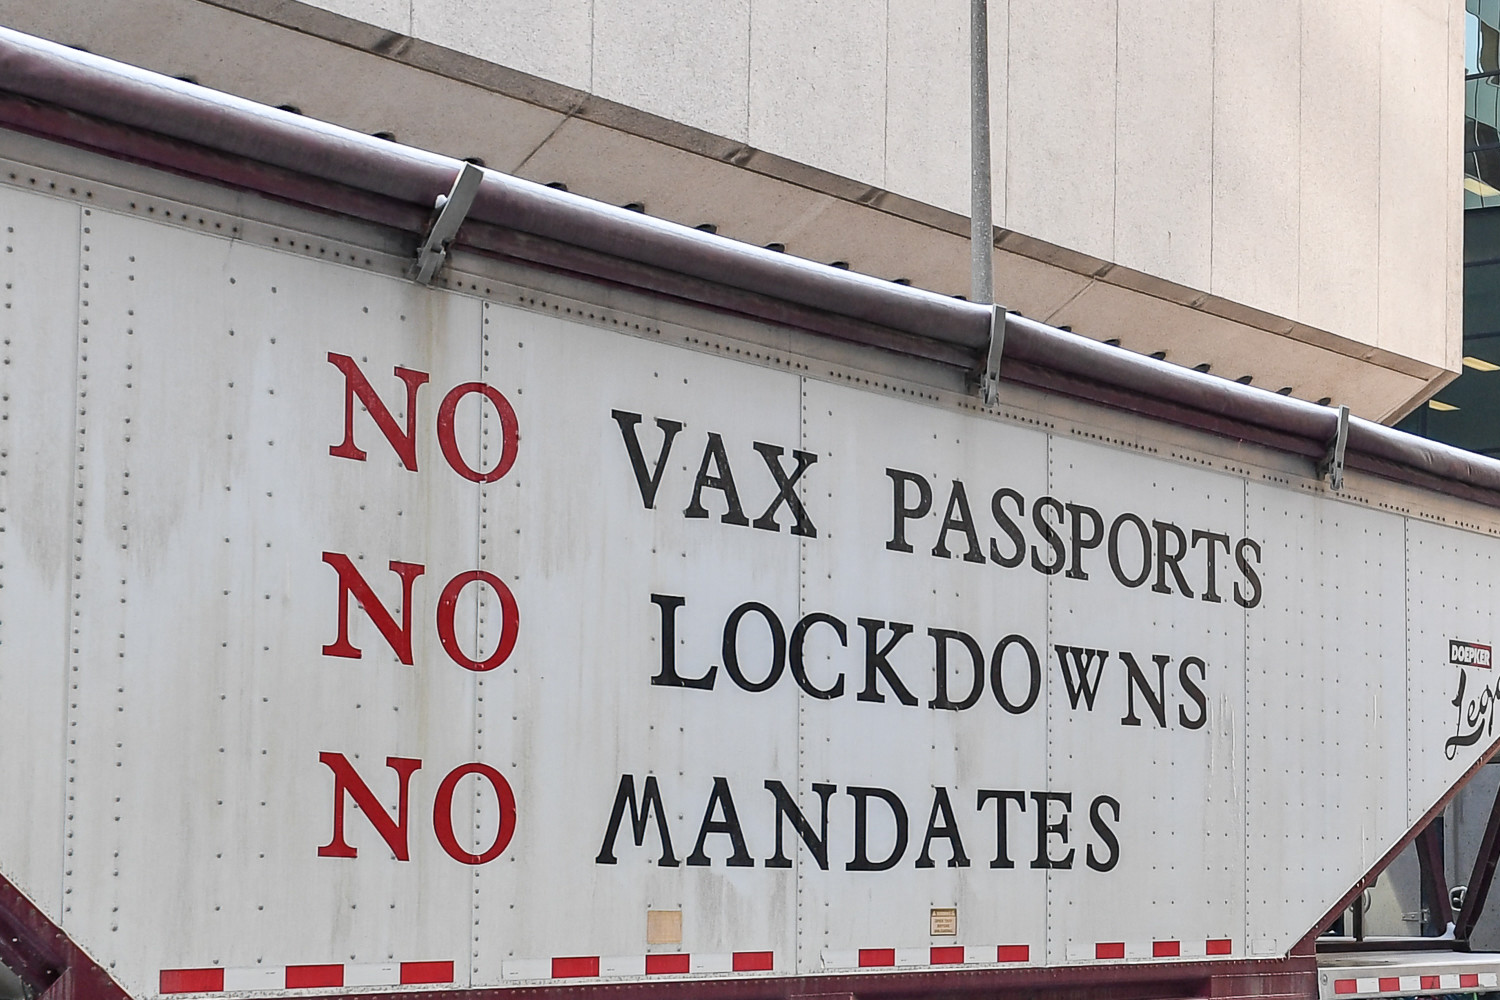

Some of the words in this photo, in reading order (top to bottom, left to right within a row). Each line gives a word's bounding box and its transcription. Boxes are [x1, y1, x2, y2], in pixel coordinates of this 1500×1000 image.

[327, 352, 519, 483] NO
[610, 408, 819, 539] VAX
[885, 467, 1263, 609] PASSPORTS
[322, 551, 520, 671] NO
[650, 593, 1207, 730] LOCKDOWNS
[1451, 644, 1490, 665] DOEPKER
[317, 751, 517, 865] NO
[595, 773, 1122, 872] MANDATES
